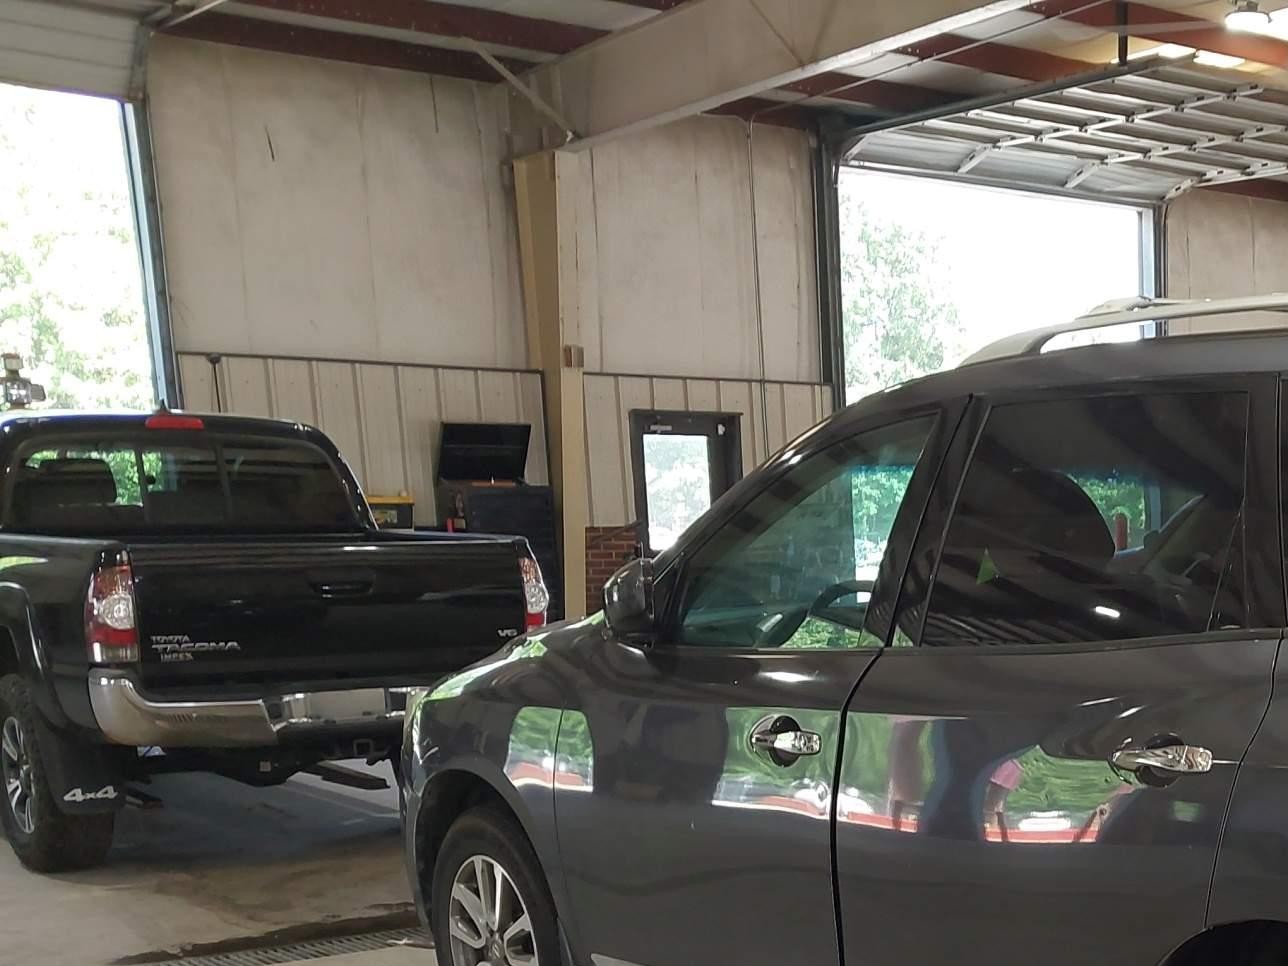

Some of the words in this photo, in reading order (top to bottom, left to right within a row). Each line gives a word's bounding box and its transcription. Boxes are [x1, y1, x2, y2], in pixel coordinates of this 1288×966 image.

[497, 629, 518, 637] V6
[151, 635, 191, 643] TOYOTA
[151, 642, 241, 653] TACOMA
[64, 785, 118, 802] 4x4
